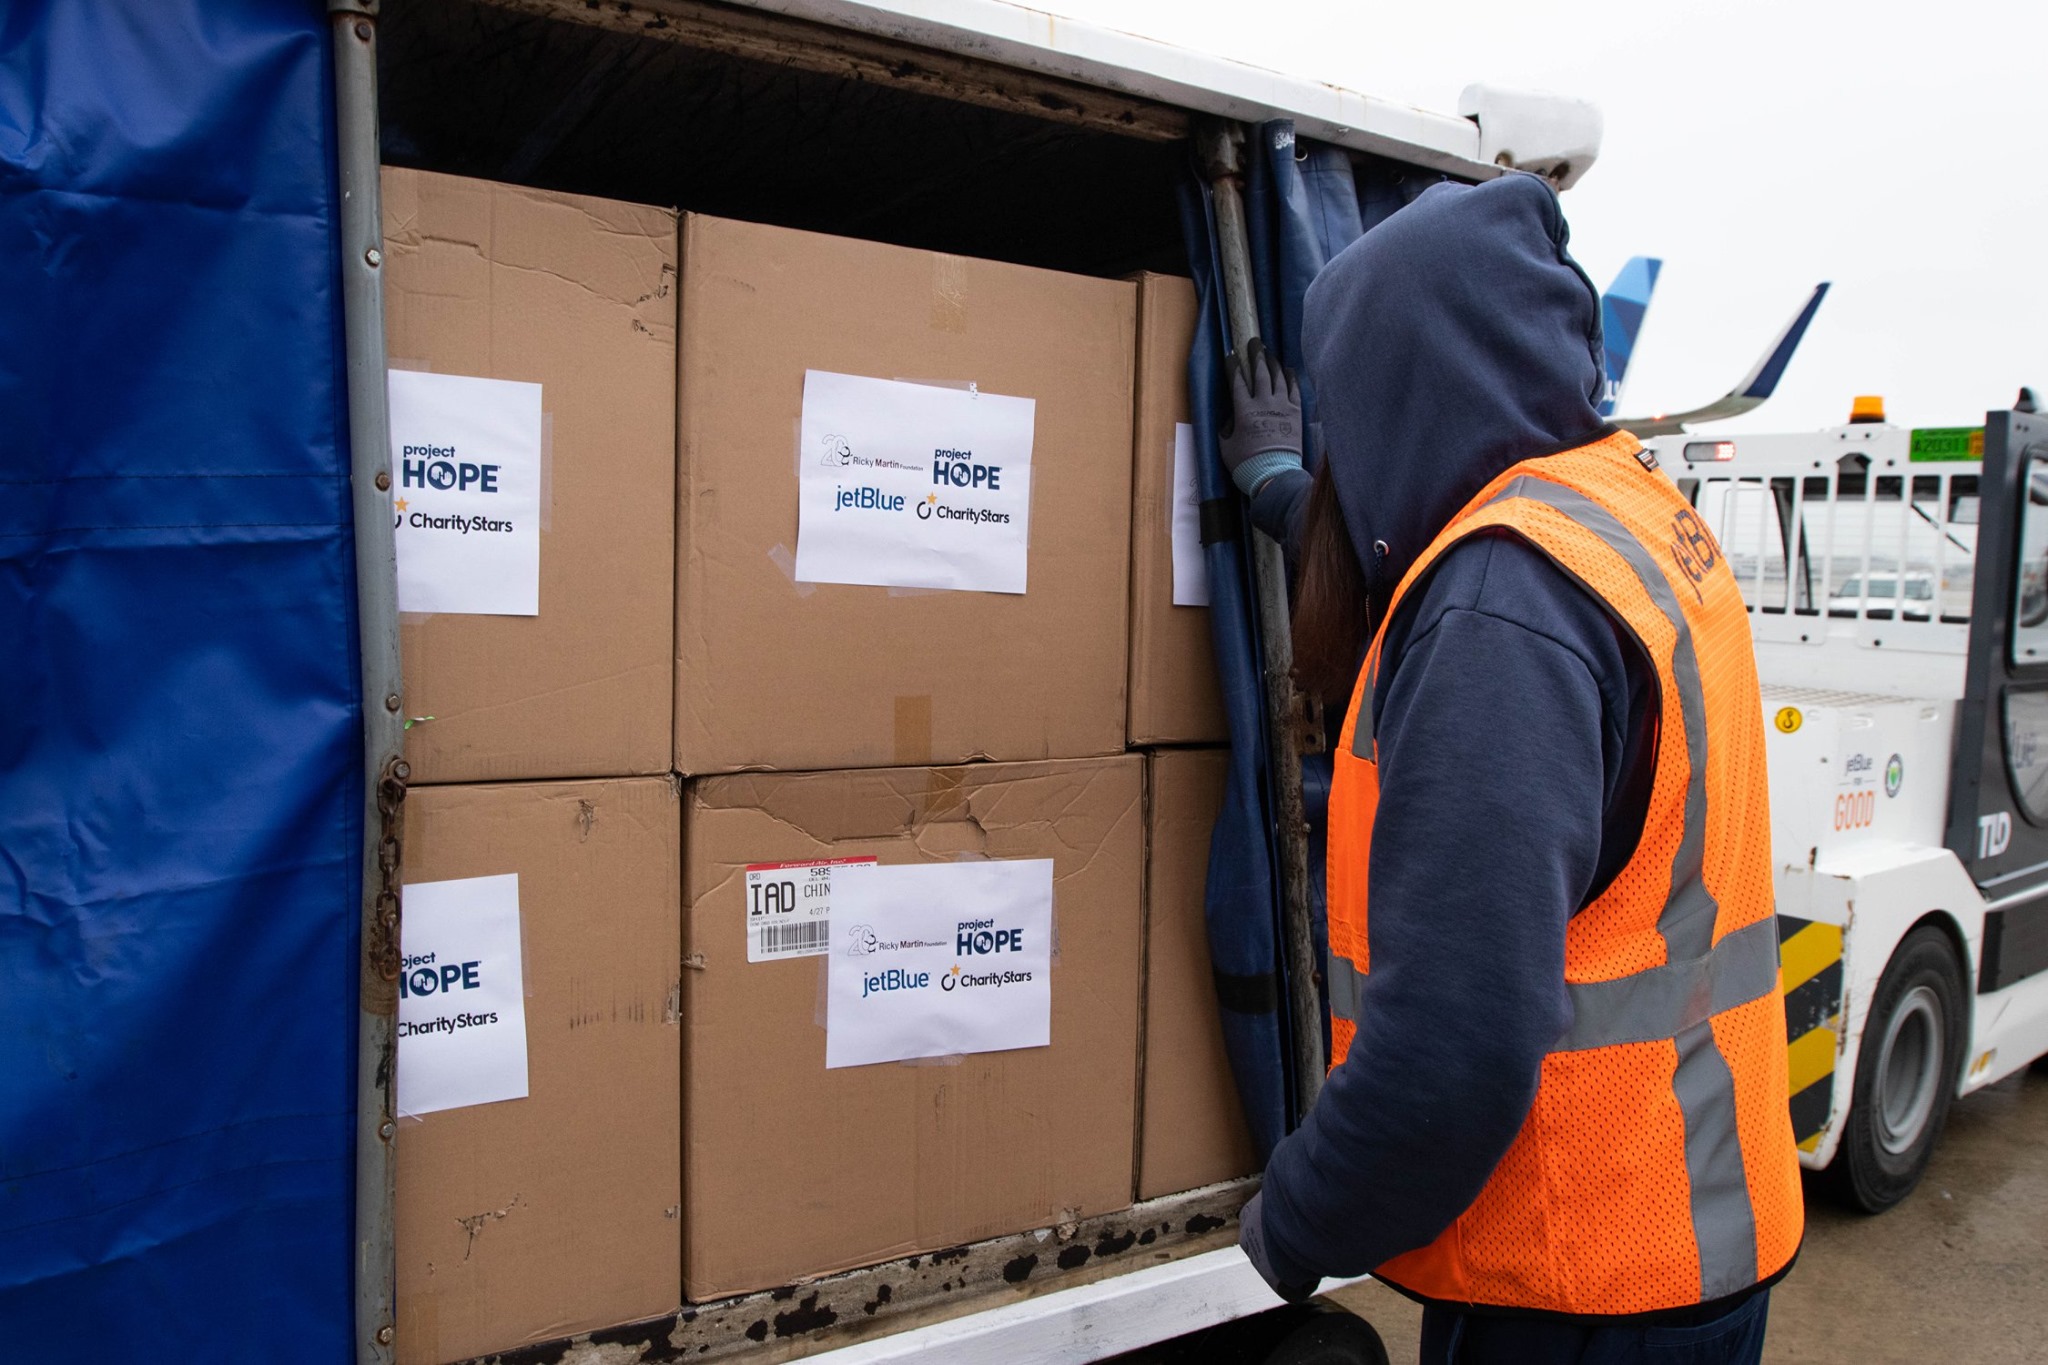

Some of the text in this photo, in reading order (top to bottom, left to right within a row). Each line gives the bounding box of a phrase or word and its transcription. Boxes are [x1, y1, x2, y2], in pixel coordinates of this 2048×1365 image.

[403, 444, 455, 459] project
[934, 448, 972, 461] project
[852, 456, 874, 468] Ricky
[875, 458, 899, 469] Martin
[900, 463, 924, 472] Foundation
[933, 460, 1001, 490] HOPE
[403, 459, 499, 493] HOPE
[835, 485, 905, 512] jetBlue
[409, 512, 513, 534] CharityStars
[936, 505, 1010, 525] CharityStars
[1834, 790, 1876, 832] GOOD
[750, 881, 796, 916] IAD
[958, 919, 994, 932] project
[879, 942, 899, 951] Ricky
[900, 940, 924, 949] Martin
[957, 928, 1022, 956] HOPE
[863, 969, 930, 998] jetBlue
[960, 971, 1032, 987] CharityStars
